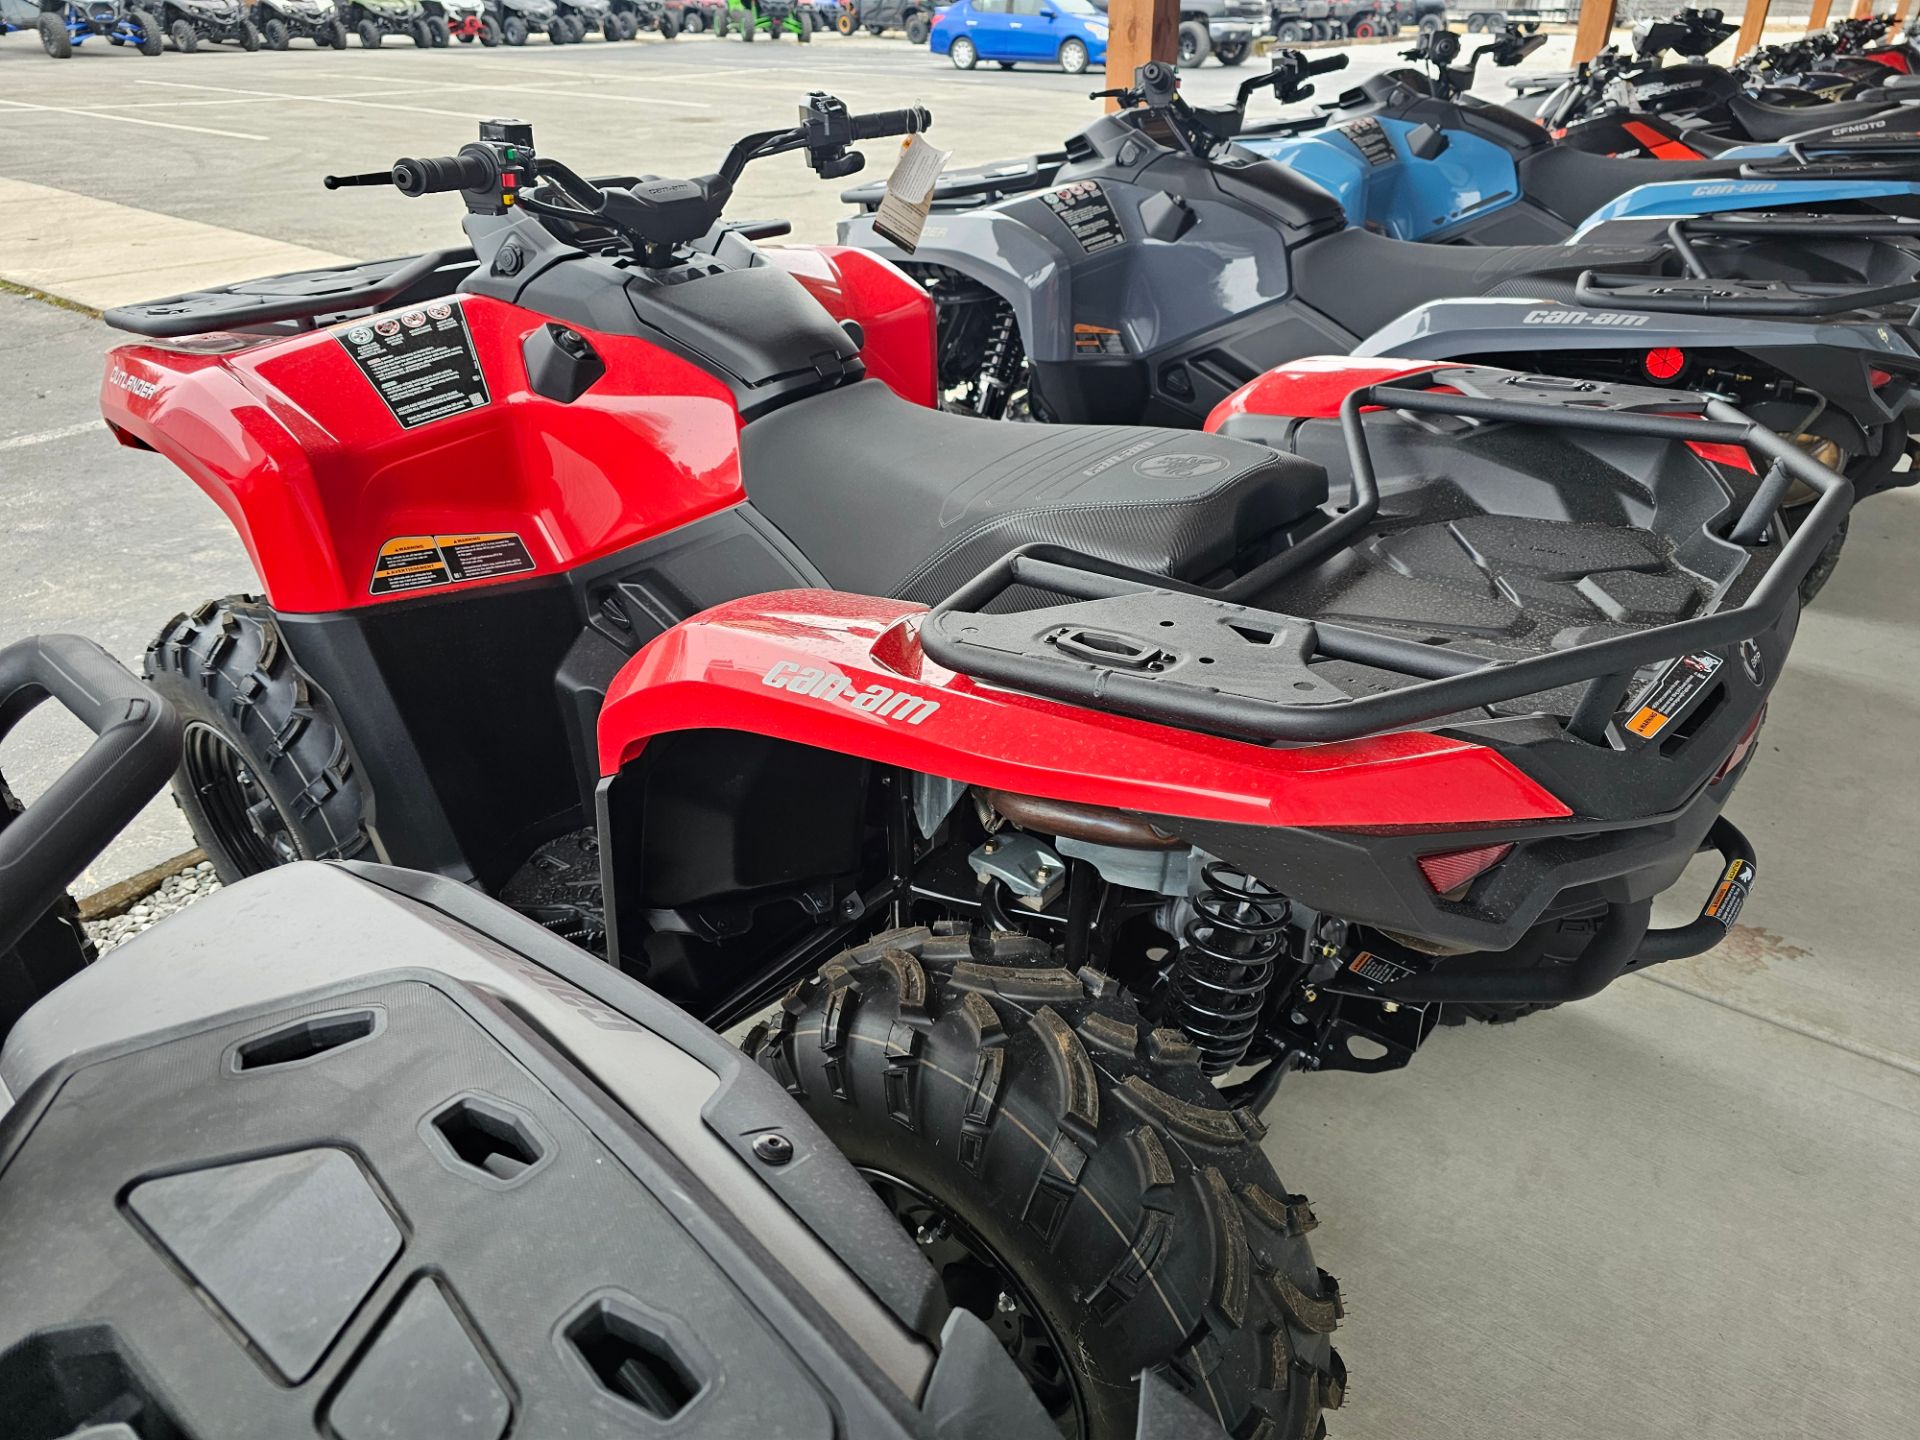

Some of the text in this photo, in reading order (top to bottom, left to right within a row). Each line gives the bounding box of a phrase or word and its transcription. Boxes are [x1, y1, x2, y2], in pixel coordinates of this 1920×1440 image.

[1832, 120, 1886, 136] CFMOTO
[1692, 183, 1777, 196] can-am
[1522, 310, 1650, 326] can-am
[109, 366, 158, 400] OUTLANDER
[1750, 651, 1761, 669] BRP
[762, 660, 941, 725] can-am
[1641, 711, 1658, 729] WARNING
